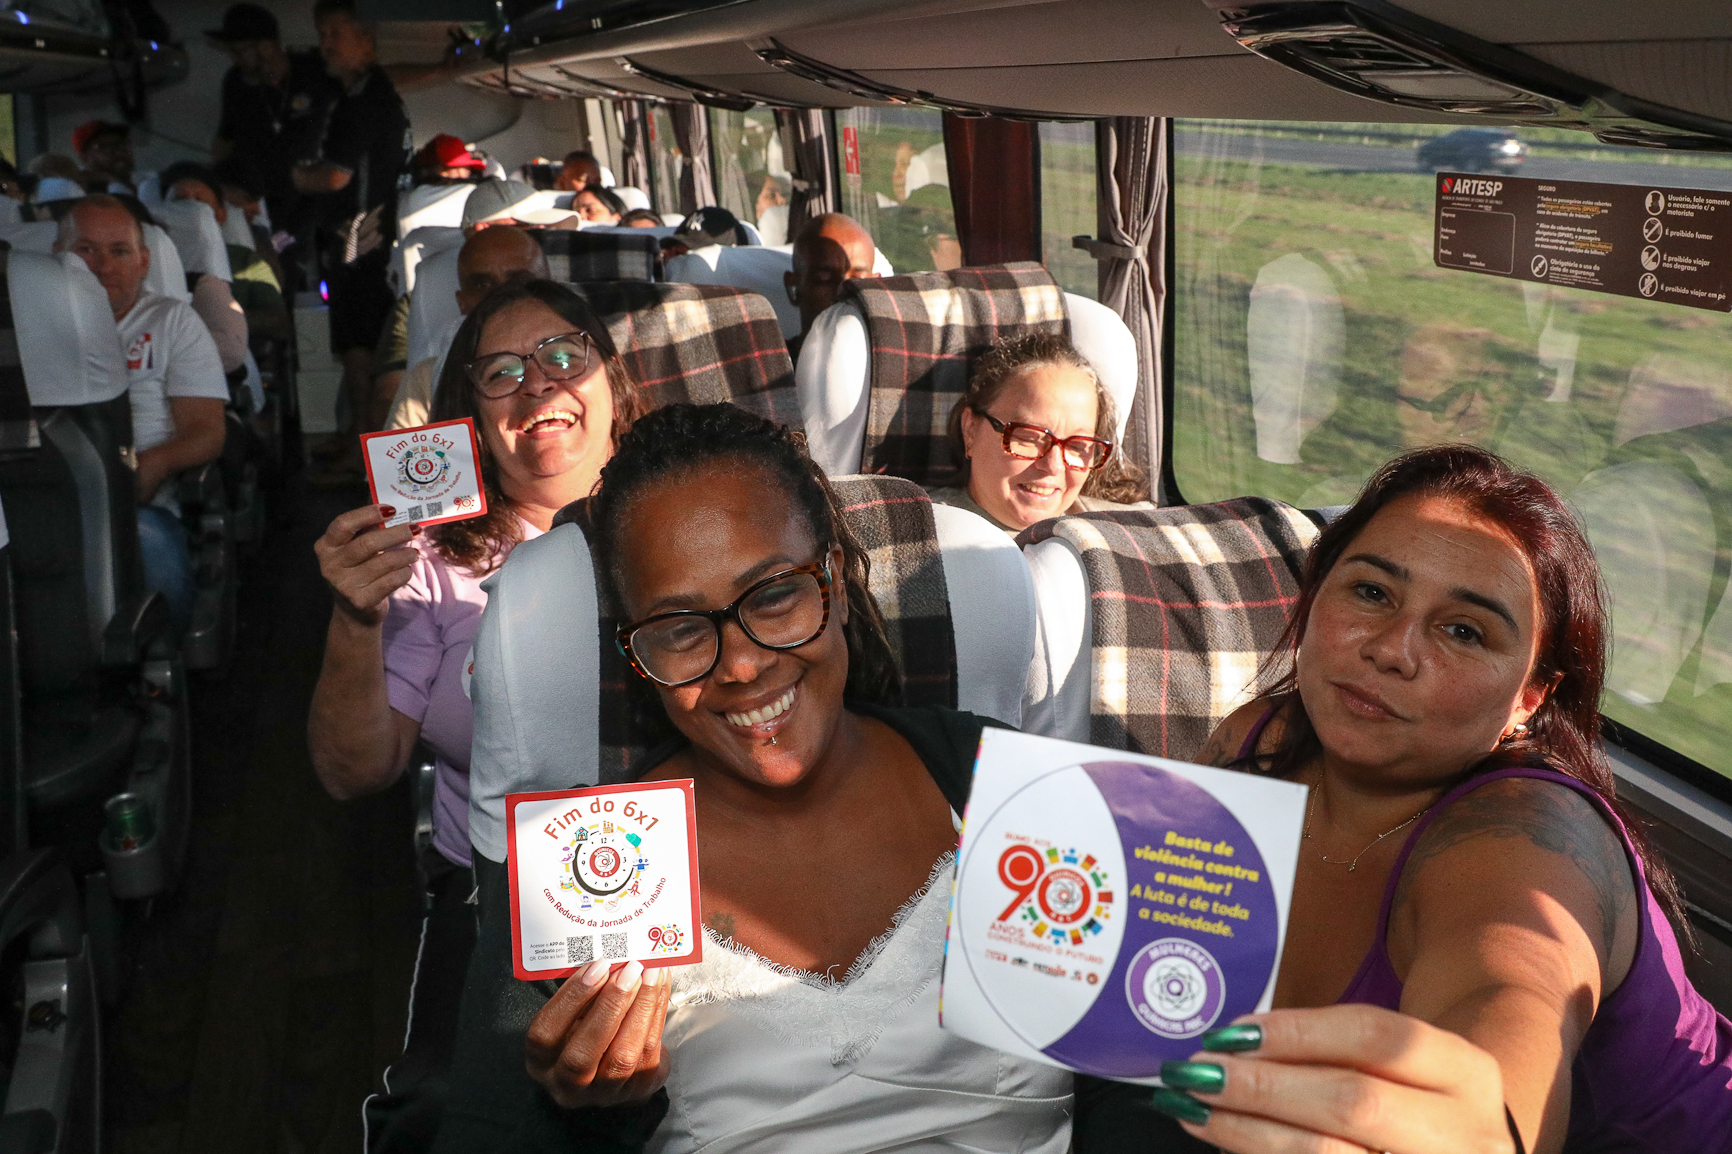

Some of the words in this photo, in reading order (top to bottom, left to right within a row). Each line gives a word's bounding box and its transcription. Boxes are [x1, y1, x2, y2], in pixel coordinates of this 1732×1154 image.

[1453, 179, 1503, 196] ARTESP
[1670, 230, 1694, 238] proibido
[1550, 259, 1578, 268] Obrigatório
[1668, 255, 1692, 264] proibido
[1693, 257, 1710, 266] viajar
[1674, 263, 1697, 271] degraus
[1570, 268, 1595, 276] segurança
[1665, 285, 1689, 294] proibido
[1690, 288, 1707, 297] viajar
[1718, 291, 1726, 300] pé
[386, 440, 408, 459] Fim
[412, 433, 427, 443] do
[432, 434, 454, 450] 6x1
[449, 472, 461, 488] Trabalho
[544, 808, 582, 839] Fim
[590, 798, 614, 813] do
[624, 801, 658, 831] 6x1
[1005, 832, 1030, 843] RUMO
[1164, 831, 1212, 853] Basta
[1213, 840, 1234, 857] de
[1135, 845, 1204, 871] violência
[1205, 862, 1259, 882] contra
[997, 844, 1091, 924] 90
[1154, 872, 1166, 883] a
[544, 888, 555, 903] com
[554, 902, 585, 924] Redução
[600, 915, 632, 927] Jornada
[634, 908, 643, 917] de
[642, 878, 666, 908] Trabalho
[1130, 883, 1142, 898] A
[1143, 885, 1175, 905] luta
[1177, 893, 1188, 907] é
[1189, 896, 1210, 912] de
[1212, 901, 1250, 920] toda
[990, 922, 1025, 939] ANOS
[1138, 908, 1150, 919] a
[1152, 910, 1234, 937] sociedade.
[648, 927, 678, 951] 90
[987, 931, 1052, 953] CONSTRUINDO
[1056, 947, 1063, 955] O
[1066, 950, 1104, 964] FUTURO
[1148, 943, 1212, 972] MULHERES
